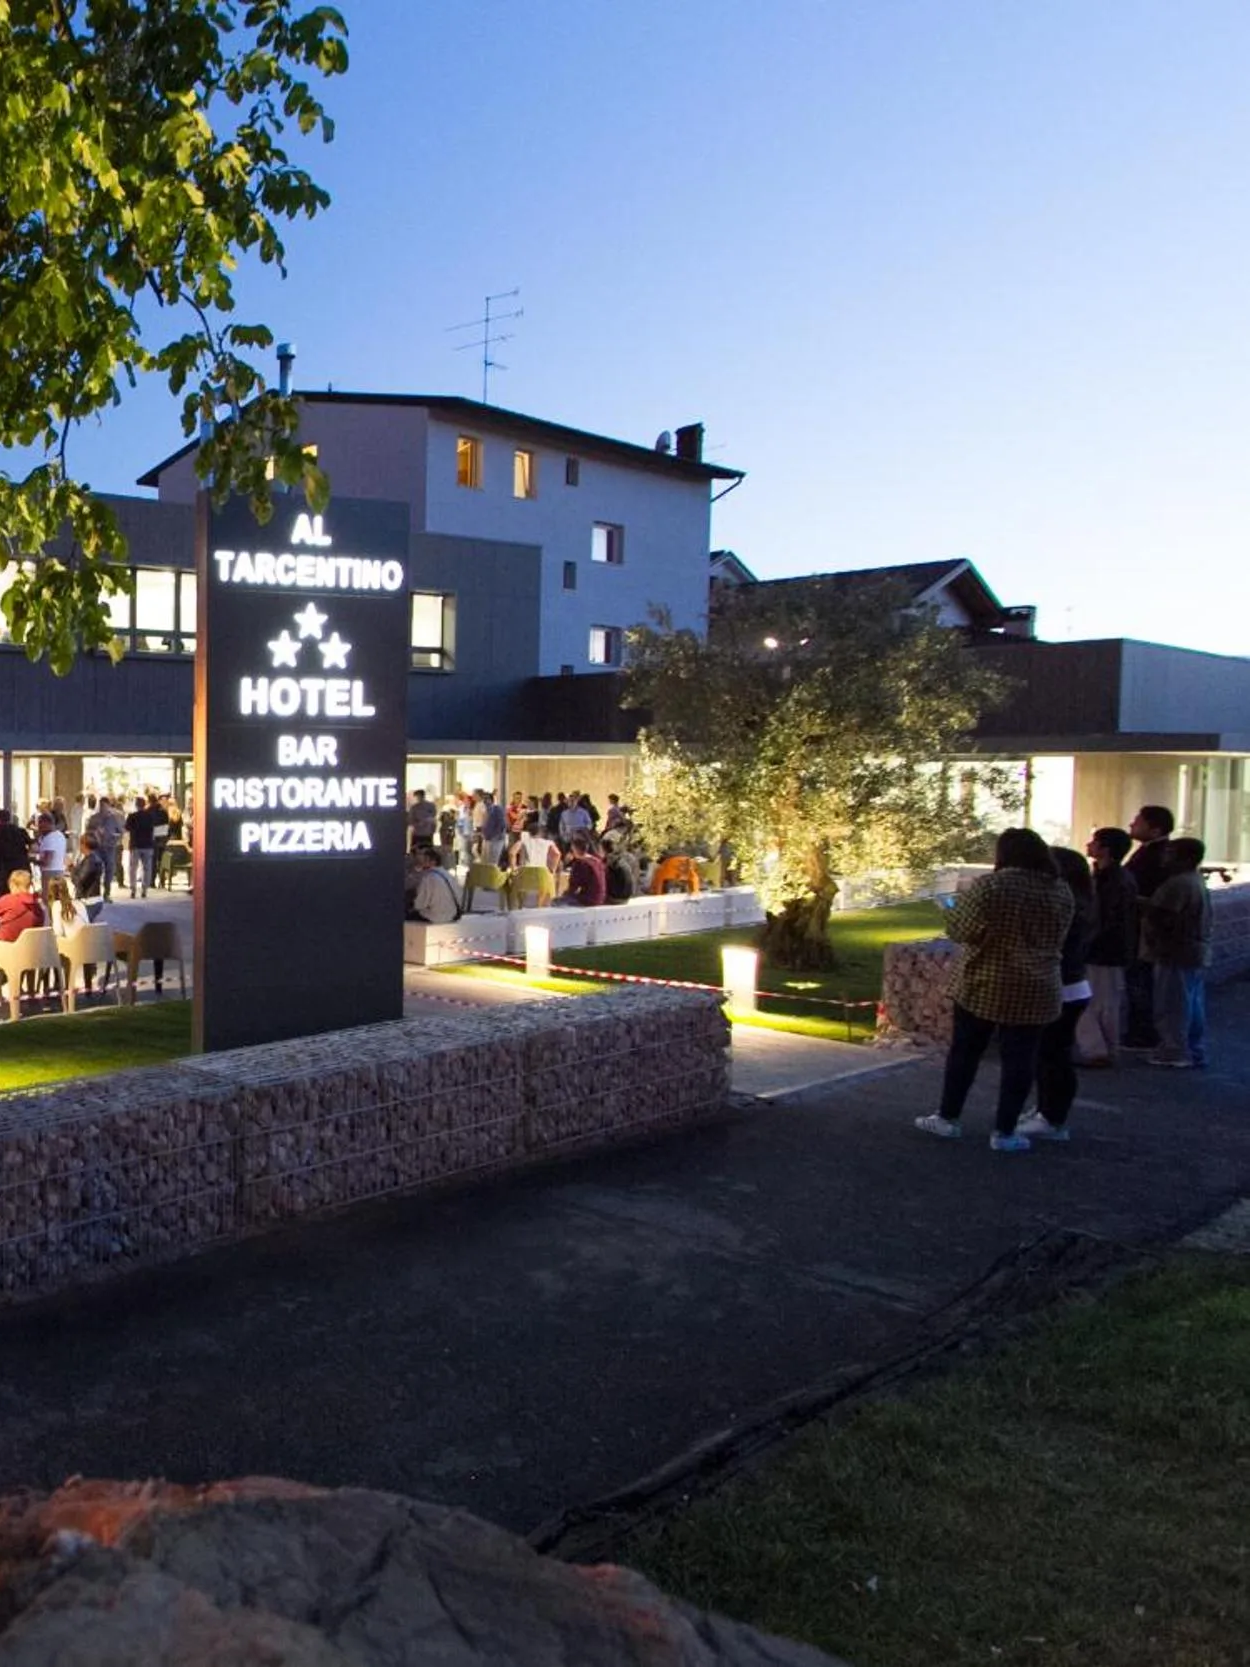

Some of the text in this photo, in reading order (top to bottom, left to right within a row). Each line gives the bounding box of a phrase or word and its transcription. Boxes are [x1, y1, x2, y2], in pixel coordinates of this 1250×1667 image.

[291, 513, 332, 546] AL
[214, 550, 403, 591] TARCENTINO
[240, 676, 375, 717] HOTEL
[277, 735, 338, 767] BAR
[213, 777, 397, 809] RISTORANTE
[240, 820, 371, 853] PIZZERIA
